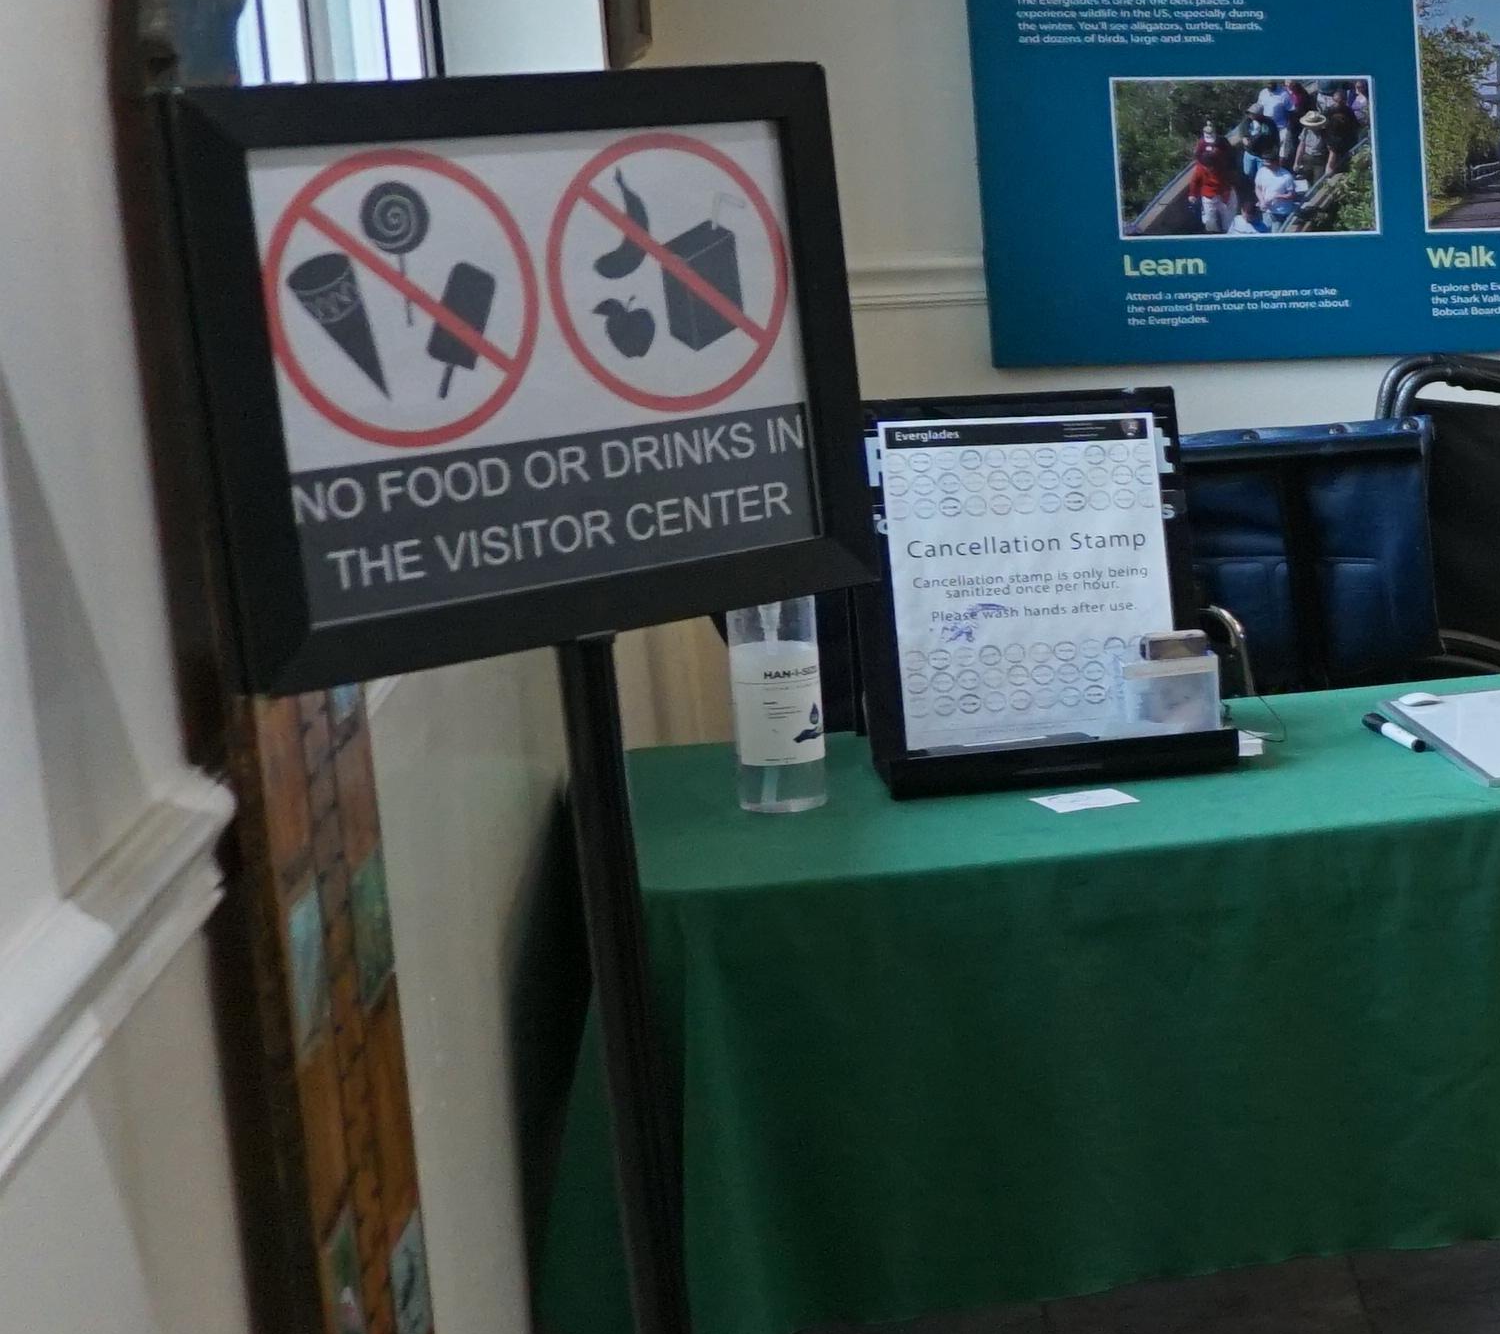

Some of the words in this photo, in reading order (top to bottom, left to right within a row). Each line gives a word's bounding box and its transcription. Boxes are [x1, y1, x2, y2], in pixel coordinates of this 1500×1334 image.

[1123, 254, 1206, 276] Learn
[1426, 246, 1496, 268] Walk
[894, 429, 960, 442] Everglades
[292, 477, 365, 525] NO
[378, 458, 511, 512] FOOD
[524, 446, 590, 490] OR
[601, 422, 756, 479] DRINKS
[766, 415, 805, 454] IN
[328, 539, 426, 590] THE
[434, 508, 613, 570] VISITOR
[625, 481, 792, 541] CENTER
[907, 535, 1060, 559] Cancellation
[1069, 531, 1146, 554] Stamp
[913, 574, 1003, 589] Cancellation
[1009, 572, 1052, 584] stamp
[1058, 569, 1068, 580] is
[1073, 568, 1102, 581] only
[1108, 566, 1148, 579] being
[946, 584, 1010, 599] sanitized
[1016, 584, 1049, 595] once
[1055, 583, 1080, 595] per
[1083, 578, 1120, 591] hour.
[932, 610, 978, 623] Please
[983, 607, 1018, 620] wash
[1024, 603, 1067, 617] hands
[1071, 601, 1104, 615] after
[1109, 600, 1137, 612] use.
